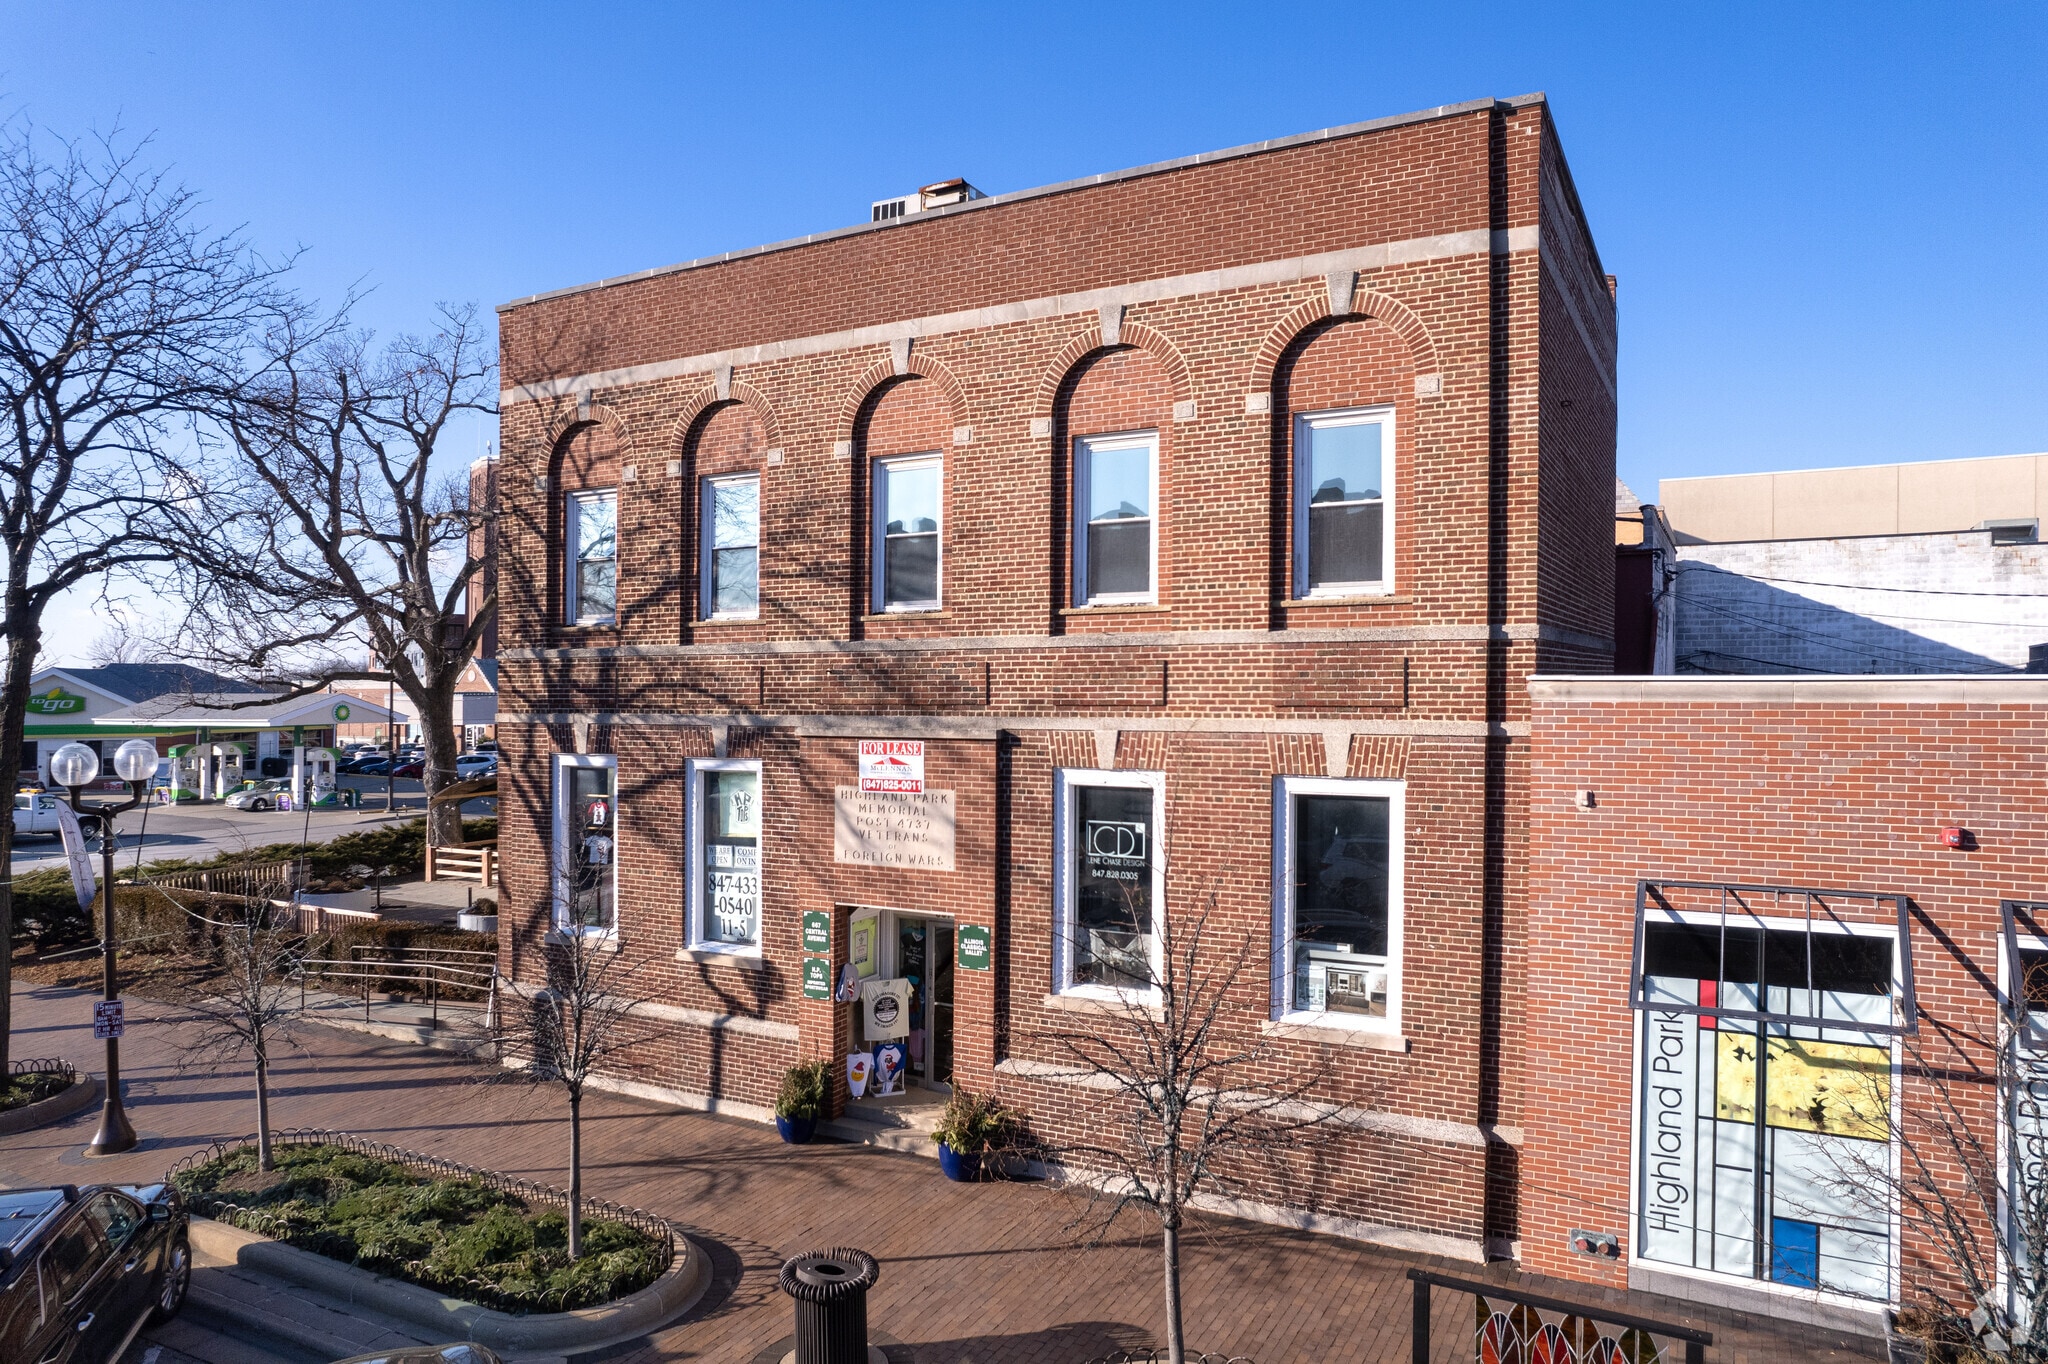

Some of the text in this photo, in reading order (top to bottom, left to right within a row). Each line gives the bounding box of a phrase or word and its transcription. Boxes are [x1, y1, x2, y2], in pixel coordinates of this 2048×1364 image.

[863, 742, 920, 756] FOR LEASE
[841, 790, 948, 804] HIGHLAND PARK
[858, 803, 928, 816] MEMORIAL
[856, 816, 890, 828] POST
[858, 829, 928, 842] VETERANS
[711, 855, 728, 864] OPEN
[737, 857, 756, 865] ON IN
[844, 849, 944, 866] FOREIGN WARS
[709, 873, 757, 896] 847-433
[721, 918, 746, 937] 11-5
[805, 927, 828, 936] CENTRAL
[810, 972, 823, 980] TOPS
[1649, 1010, 1688, 1233] Highland Park
